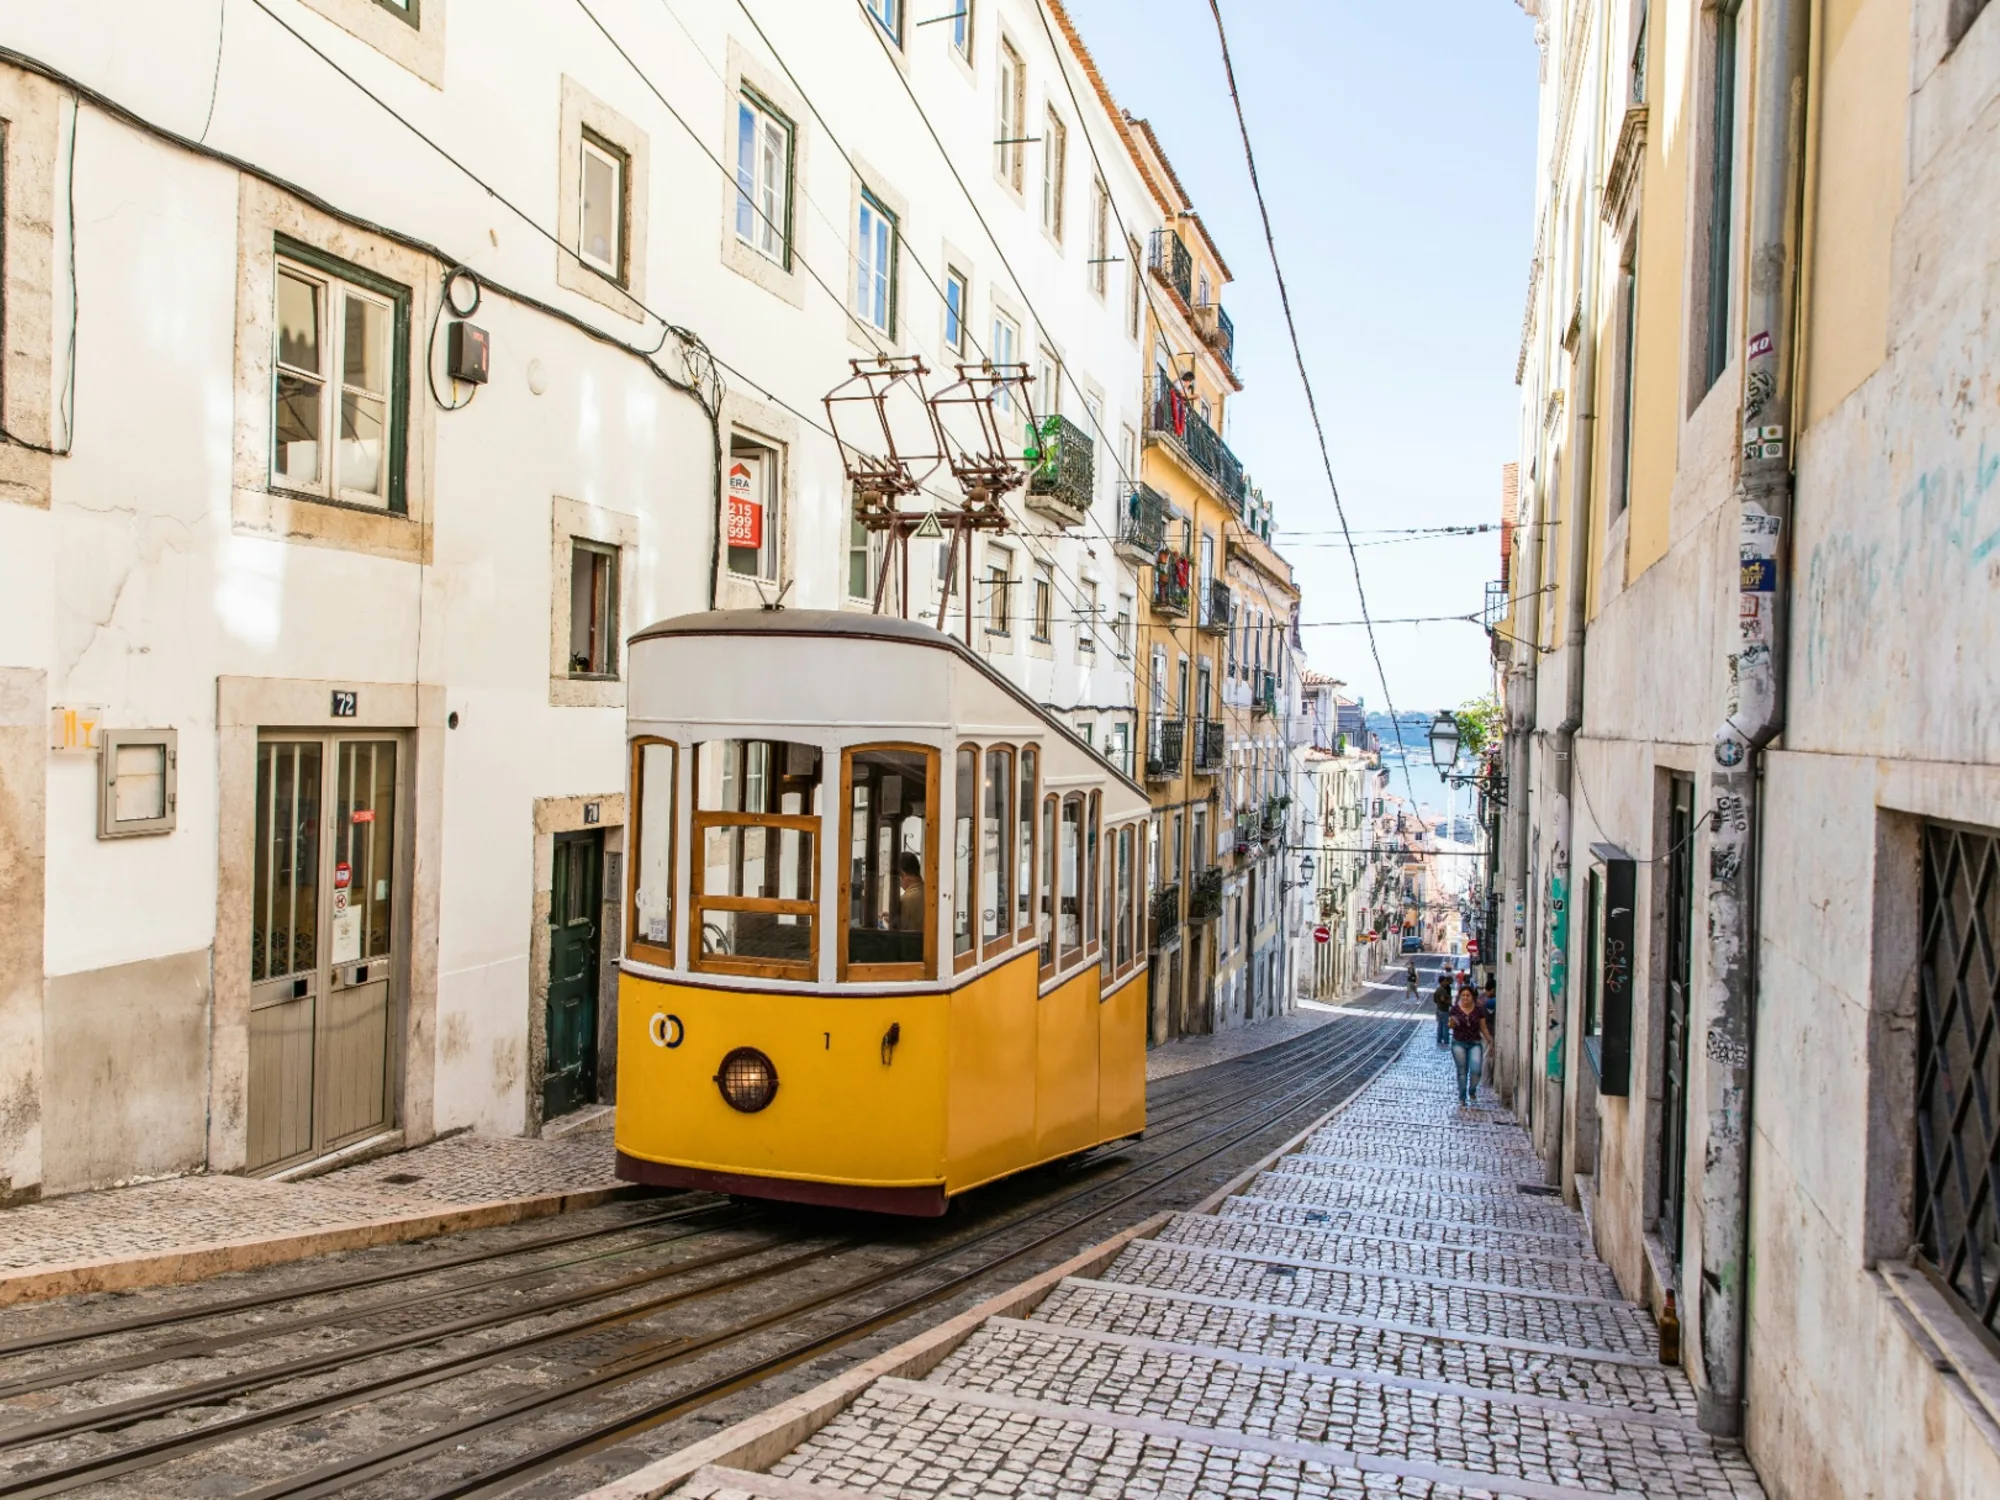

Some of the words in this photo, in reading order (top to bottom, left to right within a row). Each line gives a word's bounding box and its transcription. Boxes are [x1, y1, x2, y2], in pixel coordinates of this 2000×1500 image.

[730, 478, 750, 487] ERA
[729, 503, 752, 516] 215
[729, 514, 752, 527] 999
[729, 526, 752, 538] 995
[337, 693, 354, 715] 72
[823, 1032, 830, 1050] 1
